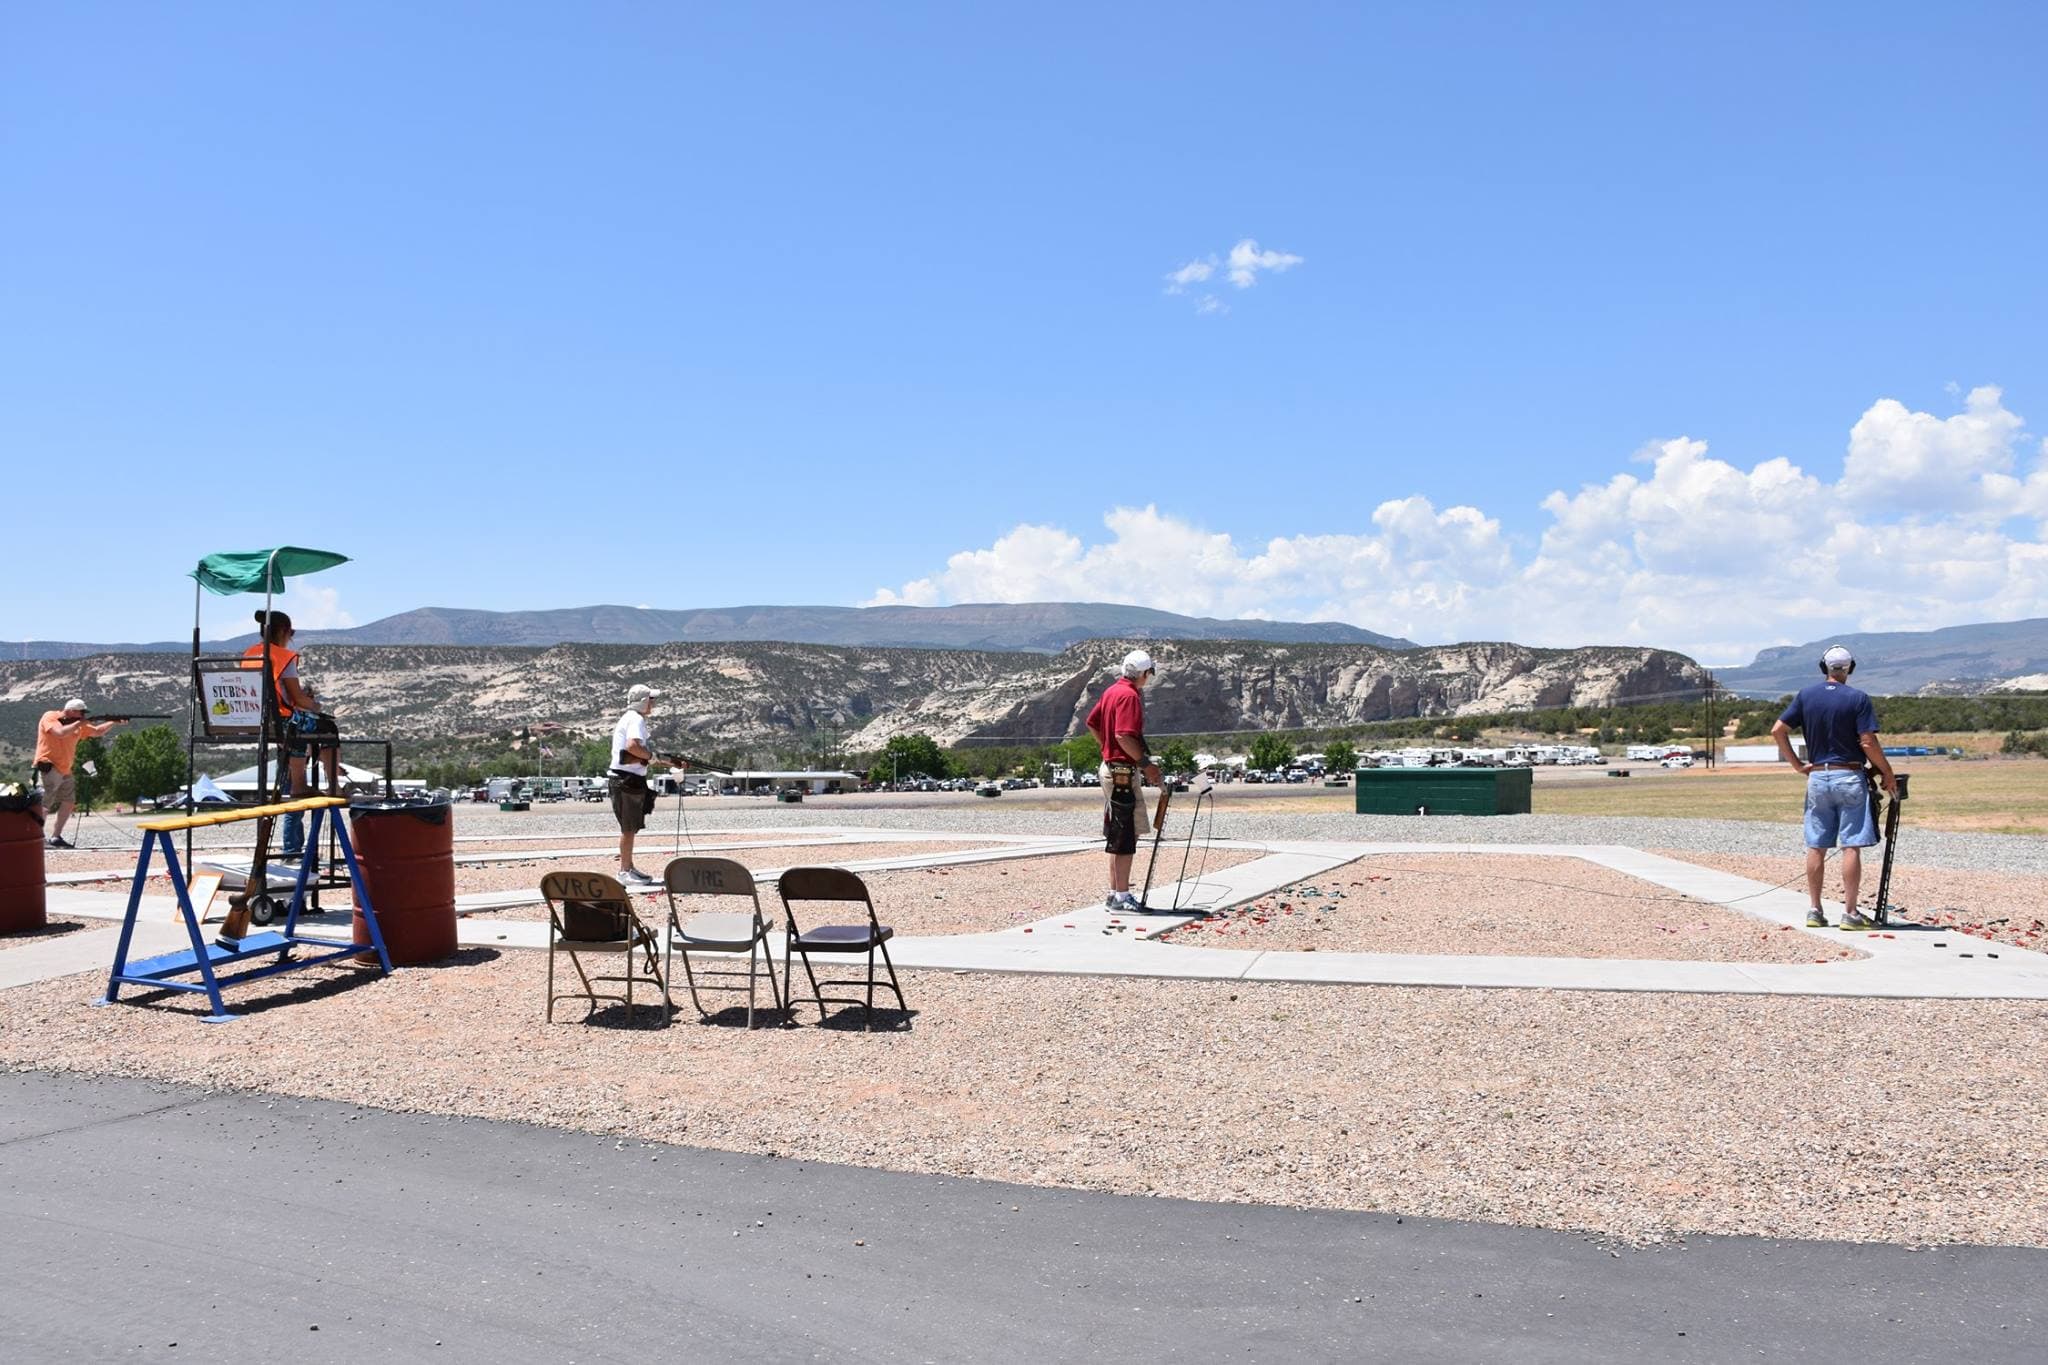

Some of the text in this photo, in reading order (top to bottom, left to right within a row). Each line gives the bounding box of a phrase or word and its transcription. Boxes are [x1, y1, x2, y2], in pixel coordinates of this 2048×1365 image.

[212, 686, 247, 698] STUBBS
[551, 876, 603, 898] VRG
[691, 869, 724, 887] VRG
